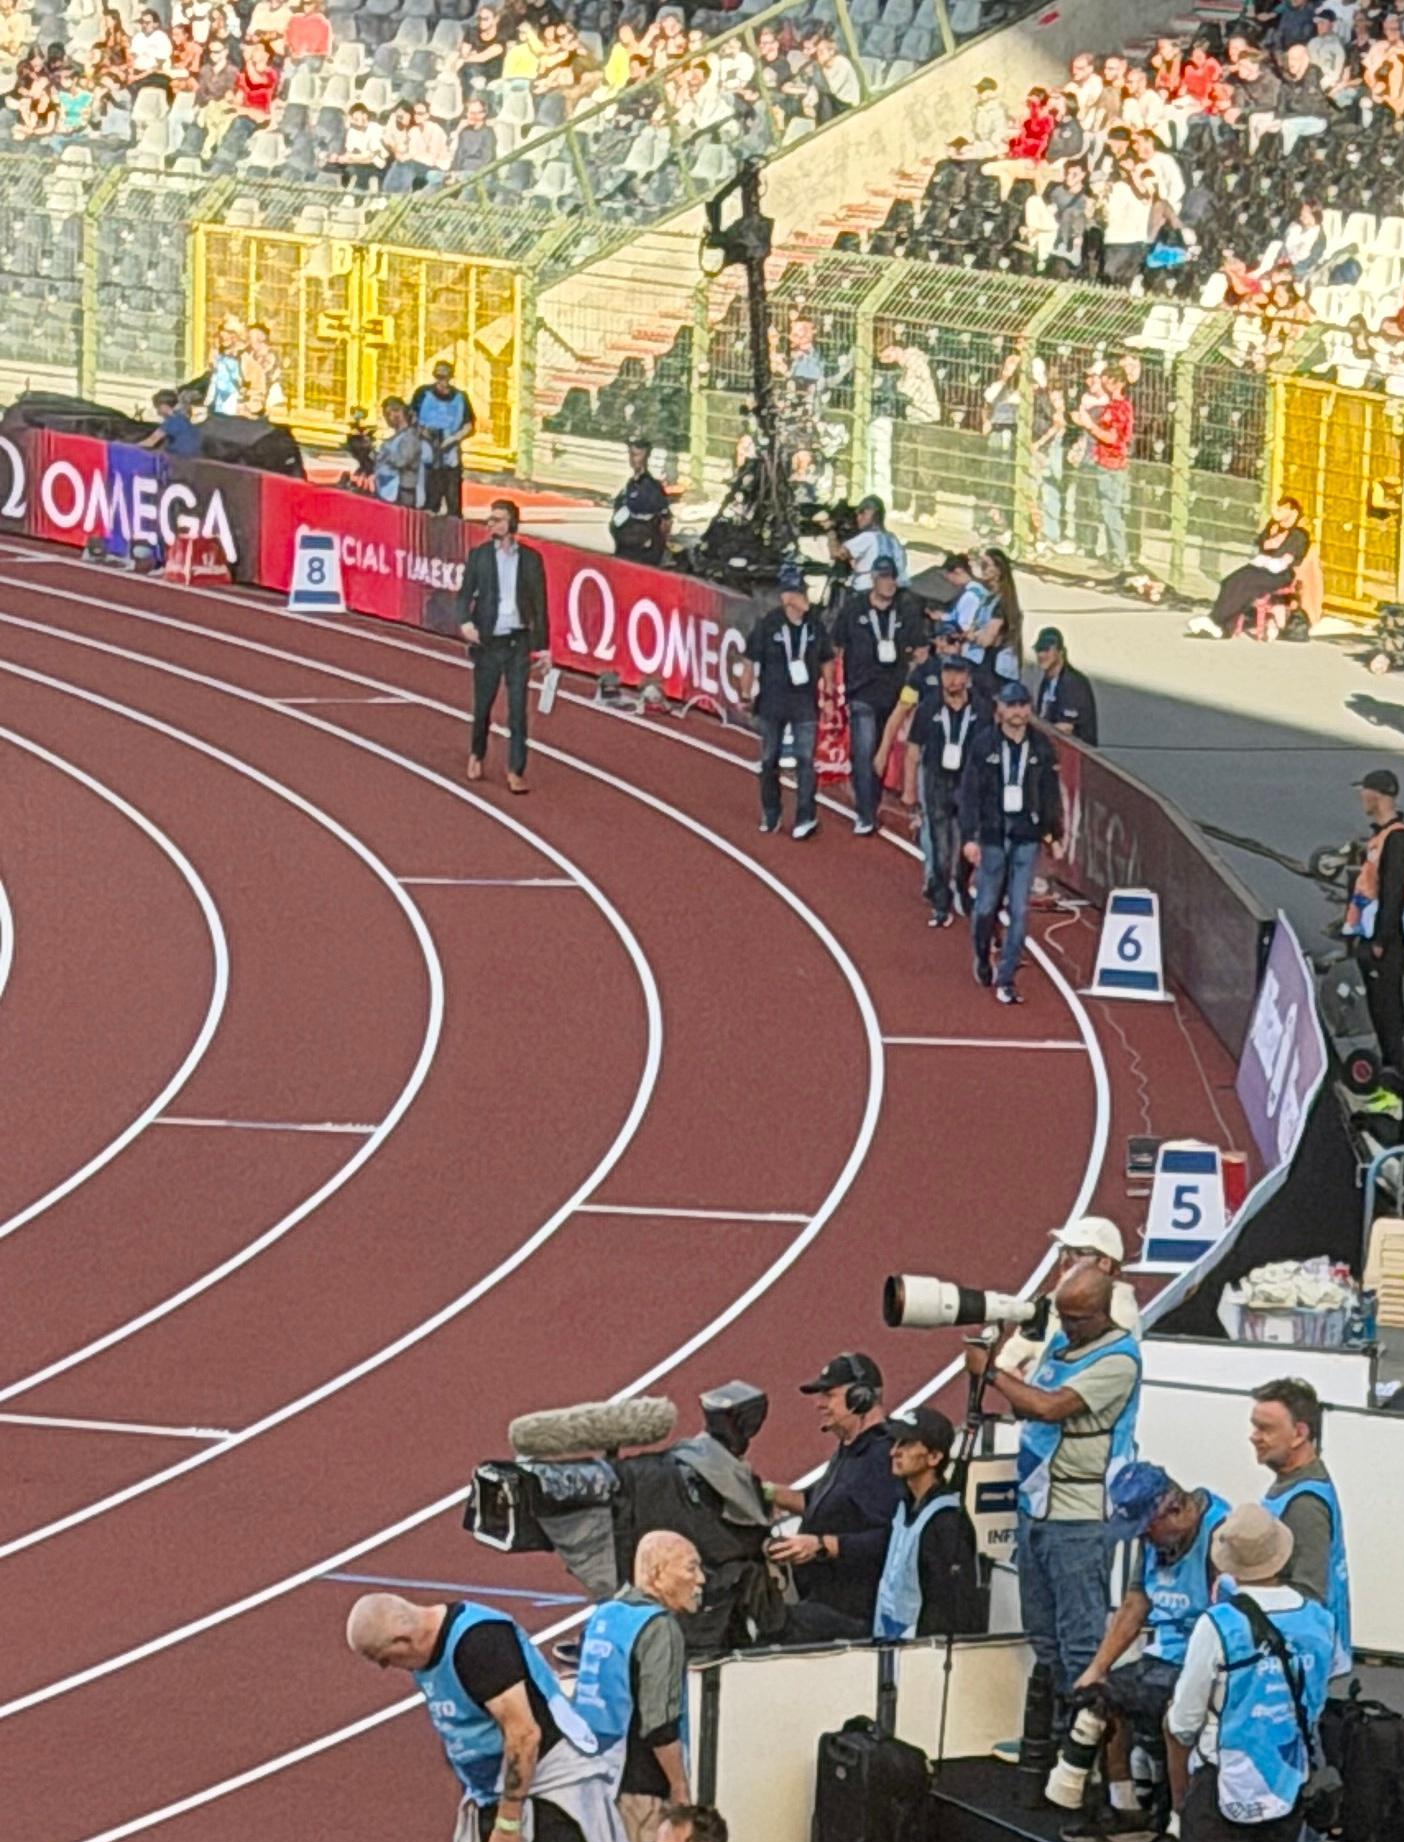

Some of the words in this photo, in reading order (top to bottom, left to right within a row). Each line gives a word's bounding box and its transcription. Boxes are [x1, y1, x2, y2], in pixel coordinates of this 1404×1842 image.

[41, 460, 238, 563] OMEGA
[306, 556, 326, 585] 8
[627, 598, 747, 703] OMEG
[1117, 924, 1142, 962] 6
[1170, 1184, 1202, 1230] 5
